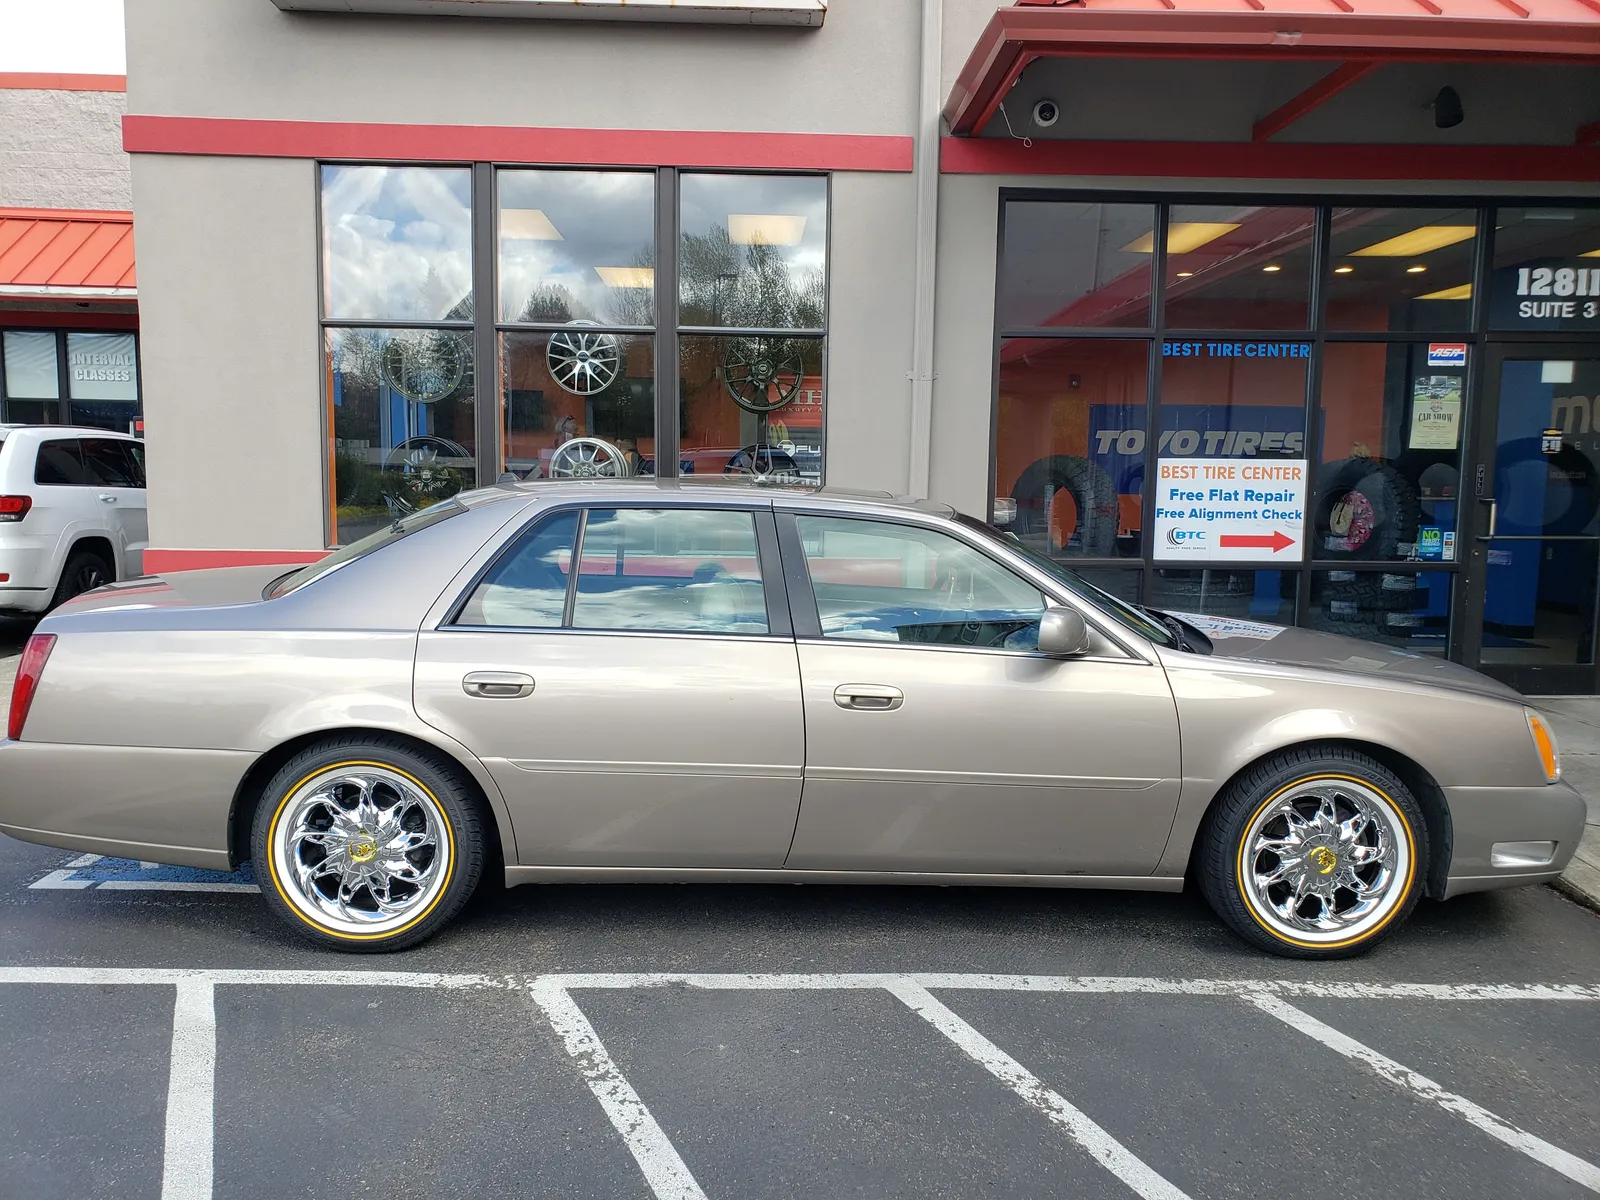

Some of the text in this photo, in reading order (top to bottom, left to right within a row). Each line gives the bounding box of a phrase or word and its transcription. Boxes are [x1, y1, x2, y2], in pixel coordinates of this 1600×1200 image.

[1519, 301, 1596, 318] SUITE 3
[1162, 342, 1310, 358] BEST TIRE CENTER
[72, 353, 132, 366] INTERVAL
[74, 368, 131, 382] CLASSES
[1418, 412, 1454, 423] CAR SHOW
[1203, 430, 1303, 456] TIRES
[1160, 465, 1301, 481] BEST TIRE CENTER
[1169, 488, 1295, 505] Free Flat Repair
[1156, 508, 1303, 521] Free Alignment Check
[1175, 530, 1206, 540] BTC
[1422, 530, 1441, 540] NO
